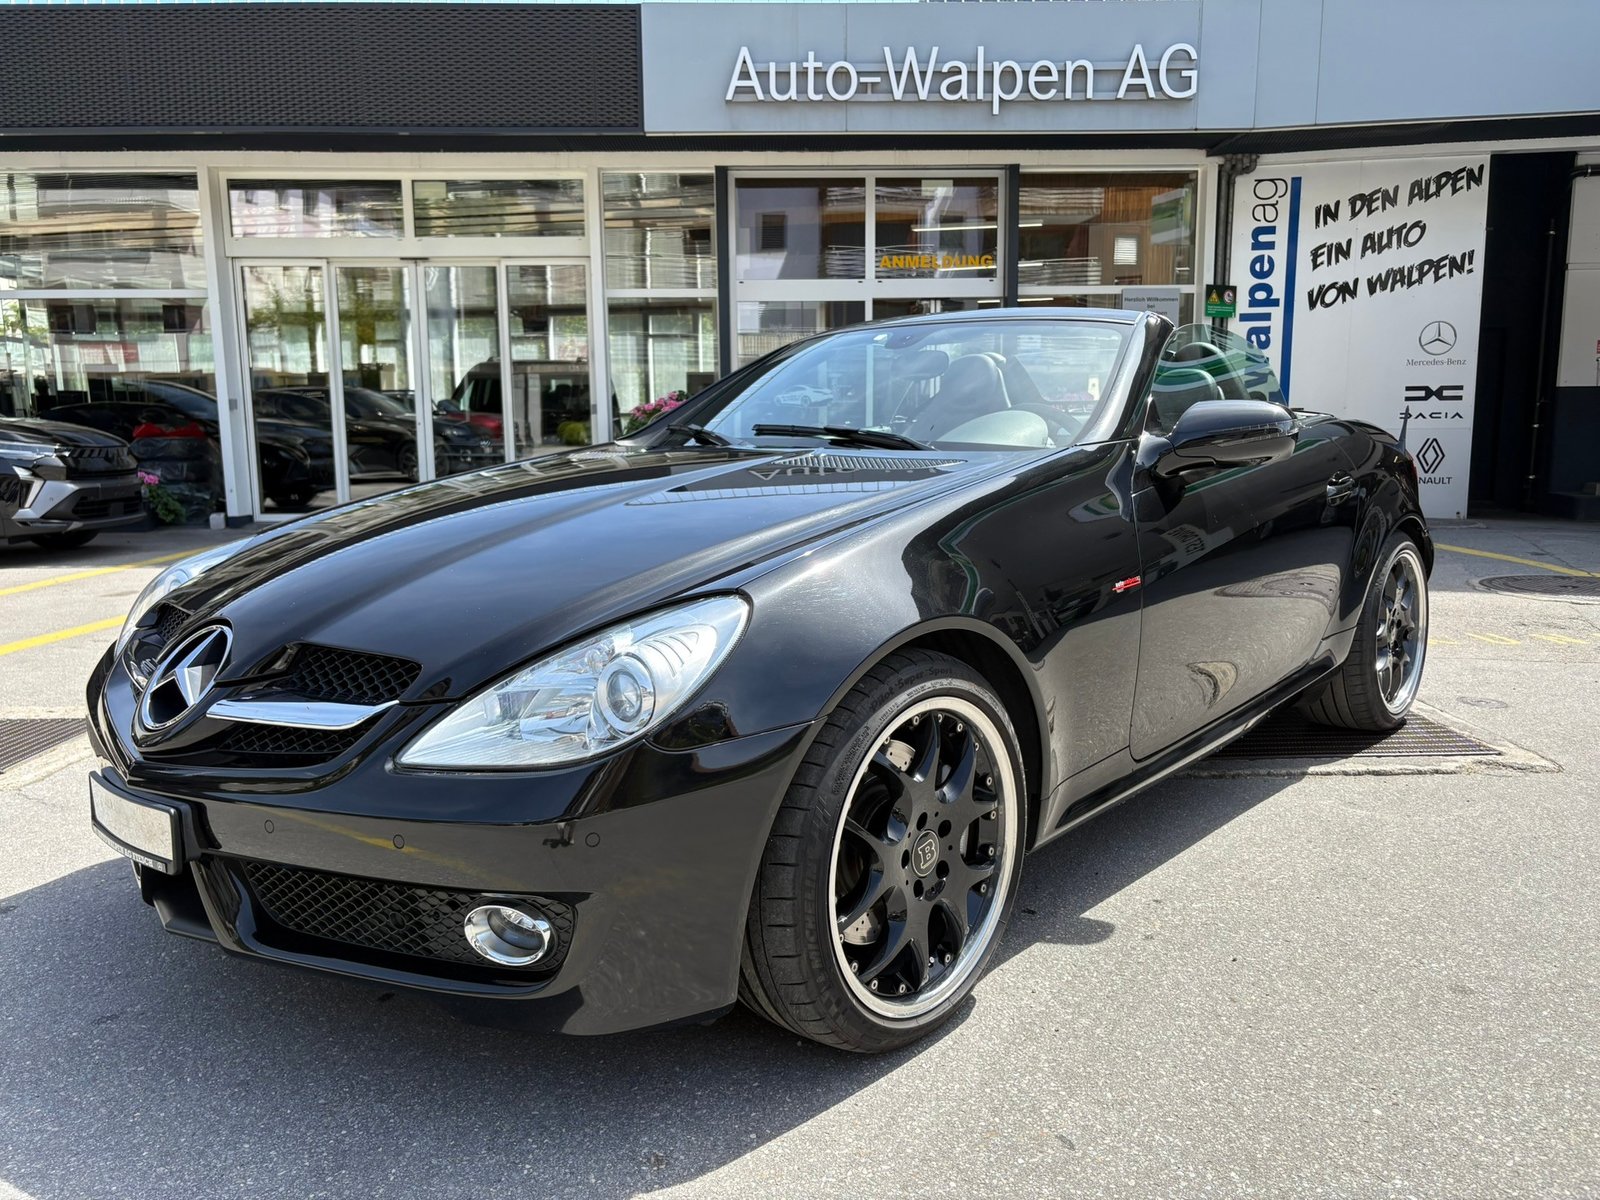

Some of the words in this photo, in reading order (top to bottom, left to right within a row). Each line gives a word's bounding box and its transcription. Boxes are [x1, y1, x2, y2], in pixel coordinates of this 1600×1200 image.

[725, 45, 1094, 115] Auto-Walpen
[1116, 43, 1198, 99] AG
[1315, 200, 1340, 229] IN
[1348, 185, 1399, 221] DEN
[1408, 164, 1484, 206] ALPEN
[880, 254, 993, 270] ANMELDUNG
[1310, 238, 1352, 271] EIN
[1360, 220, 1426, 259] AUTO
[1307, 277, 1359, 311] VON
[1367, 249, 1475, 297] WALPEN!
[1406, 358, 1467, 367] Mercedes-Benz
[1418, 476, 1453, 485] NAULT
